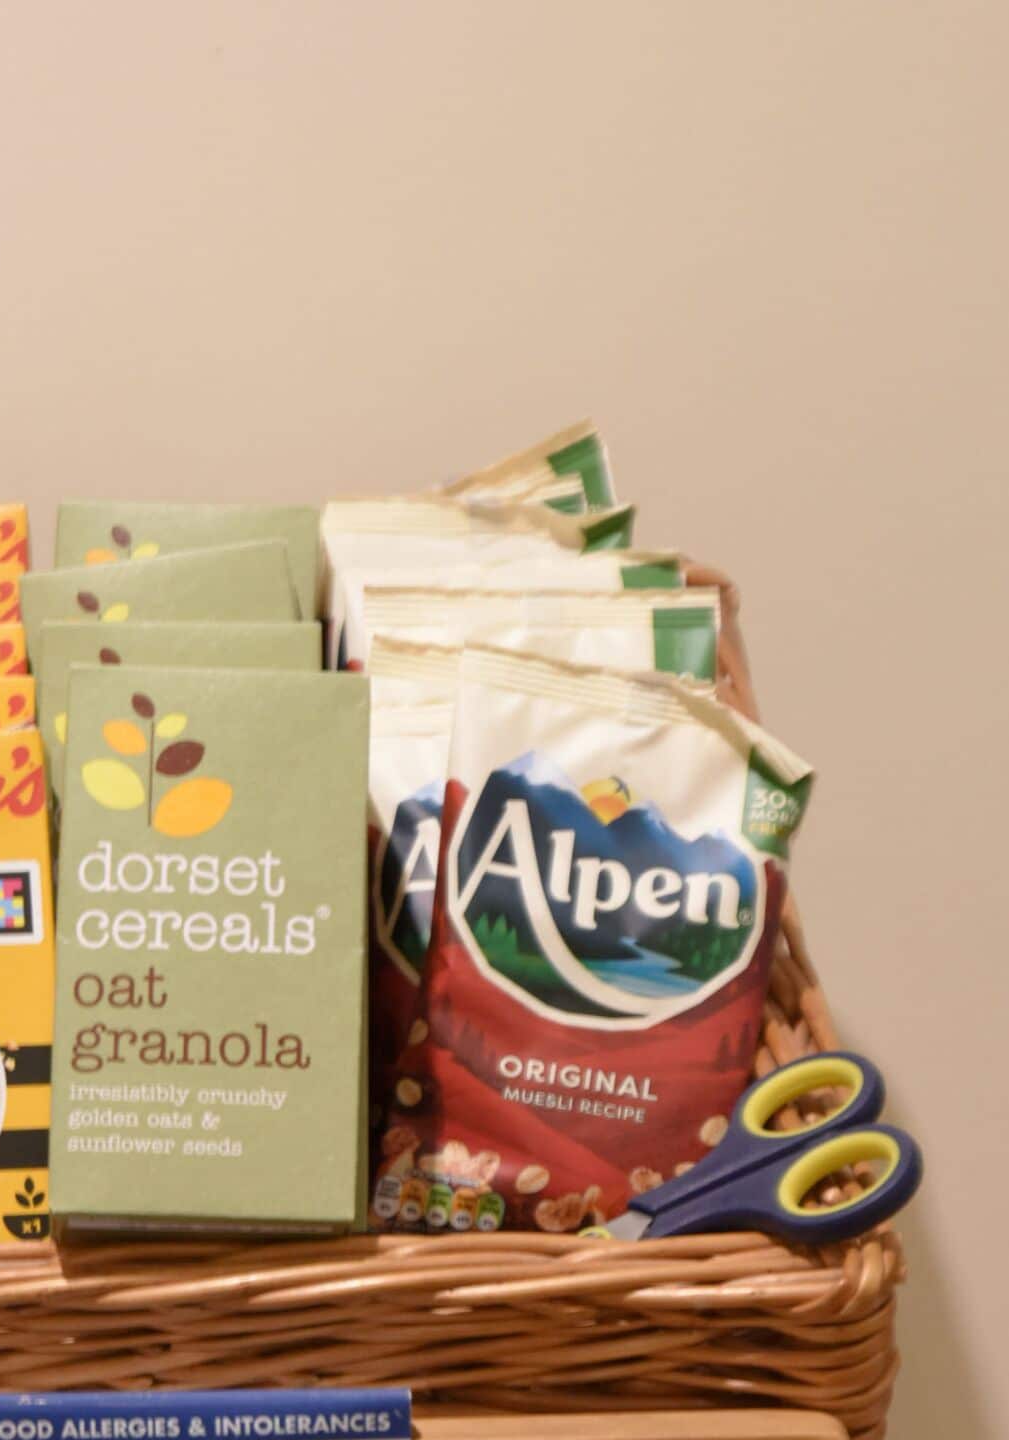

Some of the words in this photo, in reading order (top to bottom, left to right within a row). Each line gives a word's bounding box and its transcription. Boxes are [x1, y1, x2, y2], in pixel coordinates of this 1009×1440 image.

[78, 841, 285, 896] dorset
[73, 966, 168, 1010] oat
[71, 1023, 311, 1074] granola
[69, 1083, 191, 1106] irresistibly
[197, 1088, 288, 1110] crunchy
[499, 1055, 658, 1101] ORIGINAL
[67, 1110, 140, 1130] golden
[147, 1112, 193, 1130] oats
[201, 1113, 220, 1130] &
[503, 1087, 574, 1112] MUESLI
[580, 1098, 646, 1124] RECIPE
[67, 1136, 176, 1154] sunflower
[183, 1138, 243, 1157] seeds
[61, 1416, 181, 1440] ALLERGIES
[188, 1415, 207, 1437] &
[215, 1411, 391, 1436] INTOLERANCES
